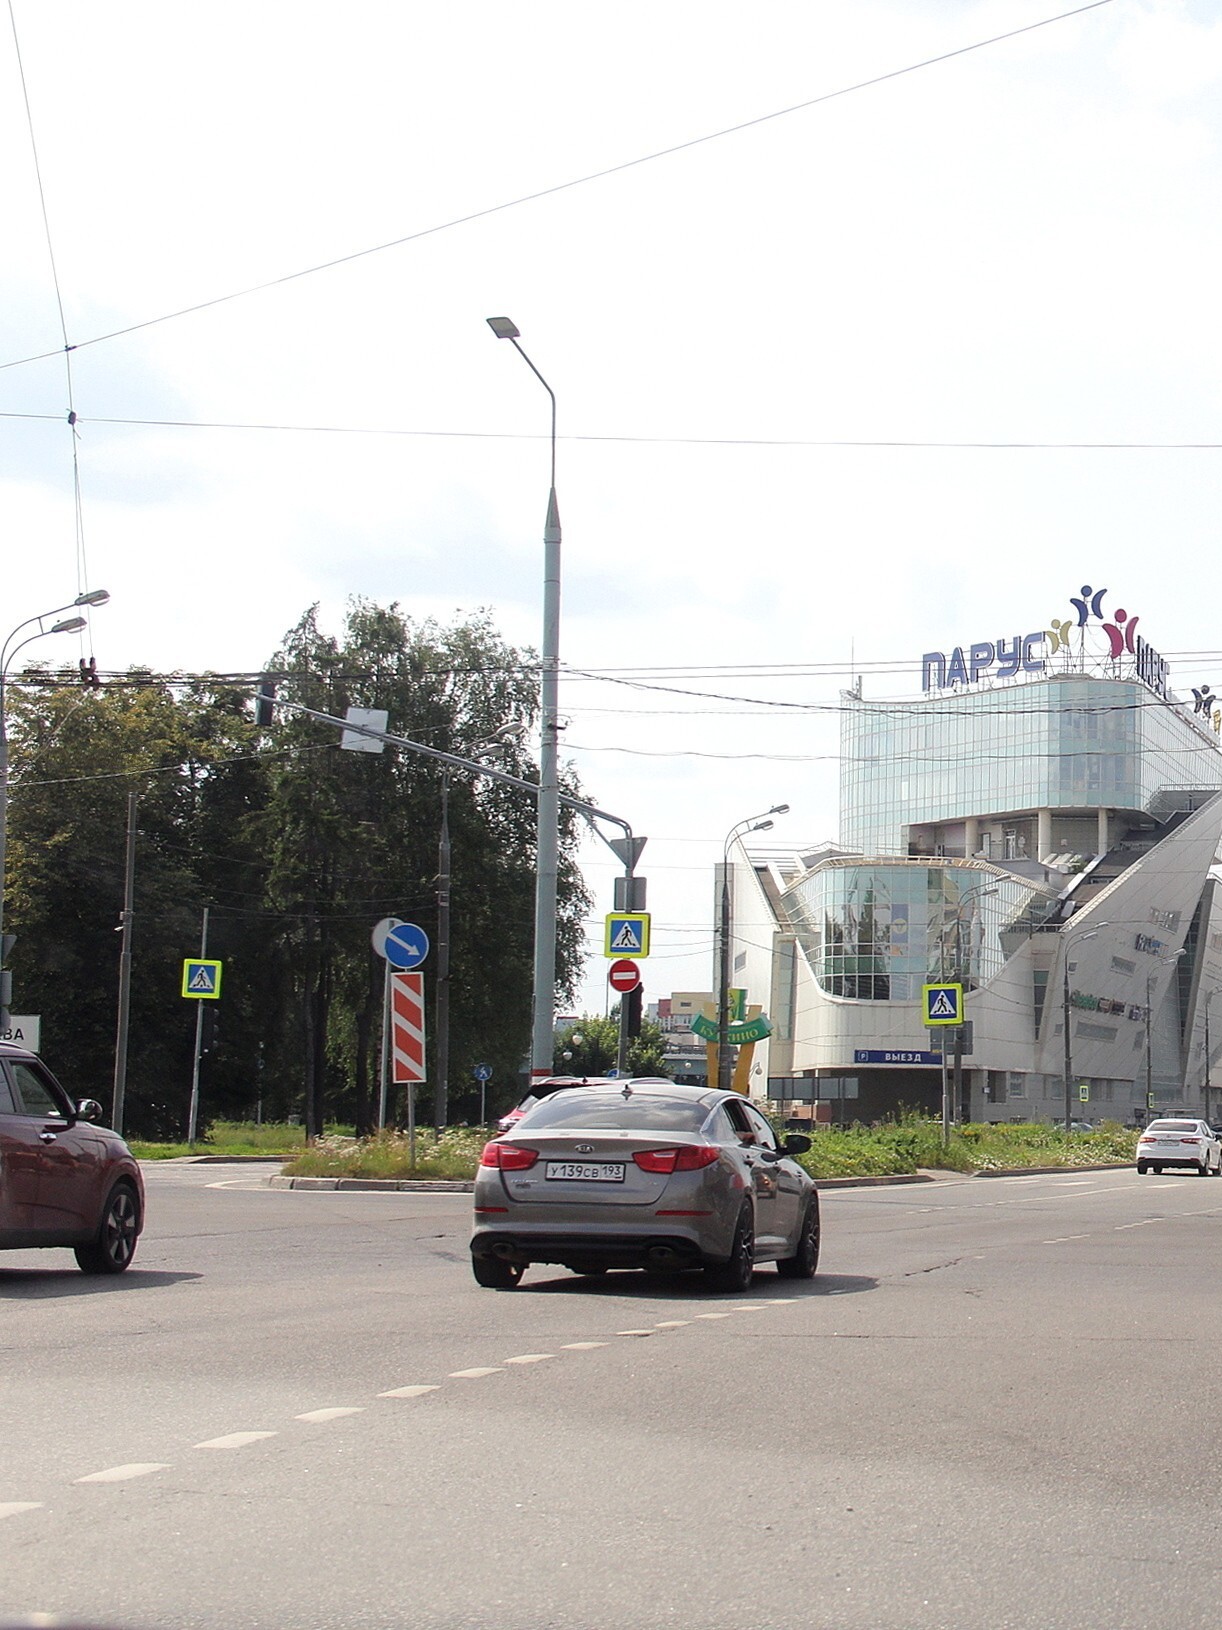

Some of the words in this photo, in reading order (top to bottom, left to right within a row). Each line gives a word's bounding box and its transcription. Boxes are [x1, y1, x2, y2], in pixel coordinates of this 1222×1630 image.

[922, 631, 1046, 692] ПАРУС
[0, 1028, 25, 1041] ВА
[885, 1053, 922, 1063] ВЫЕЗД
